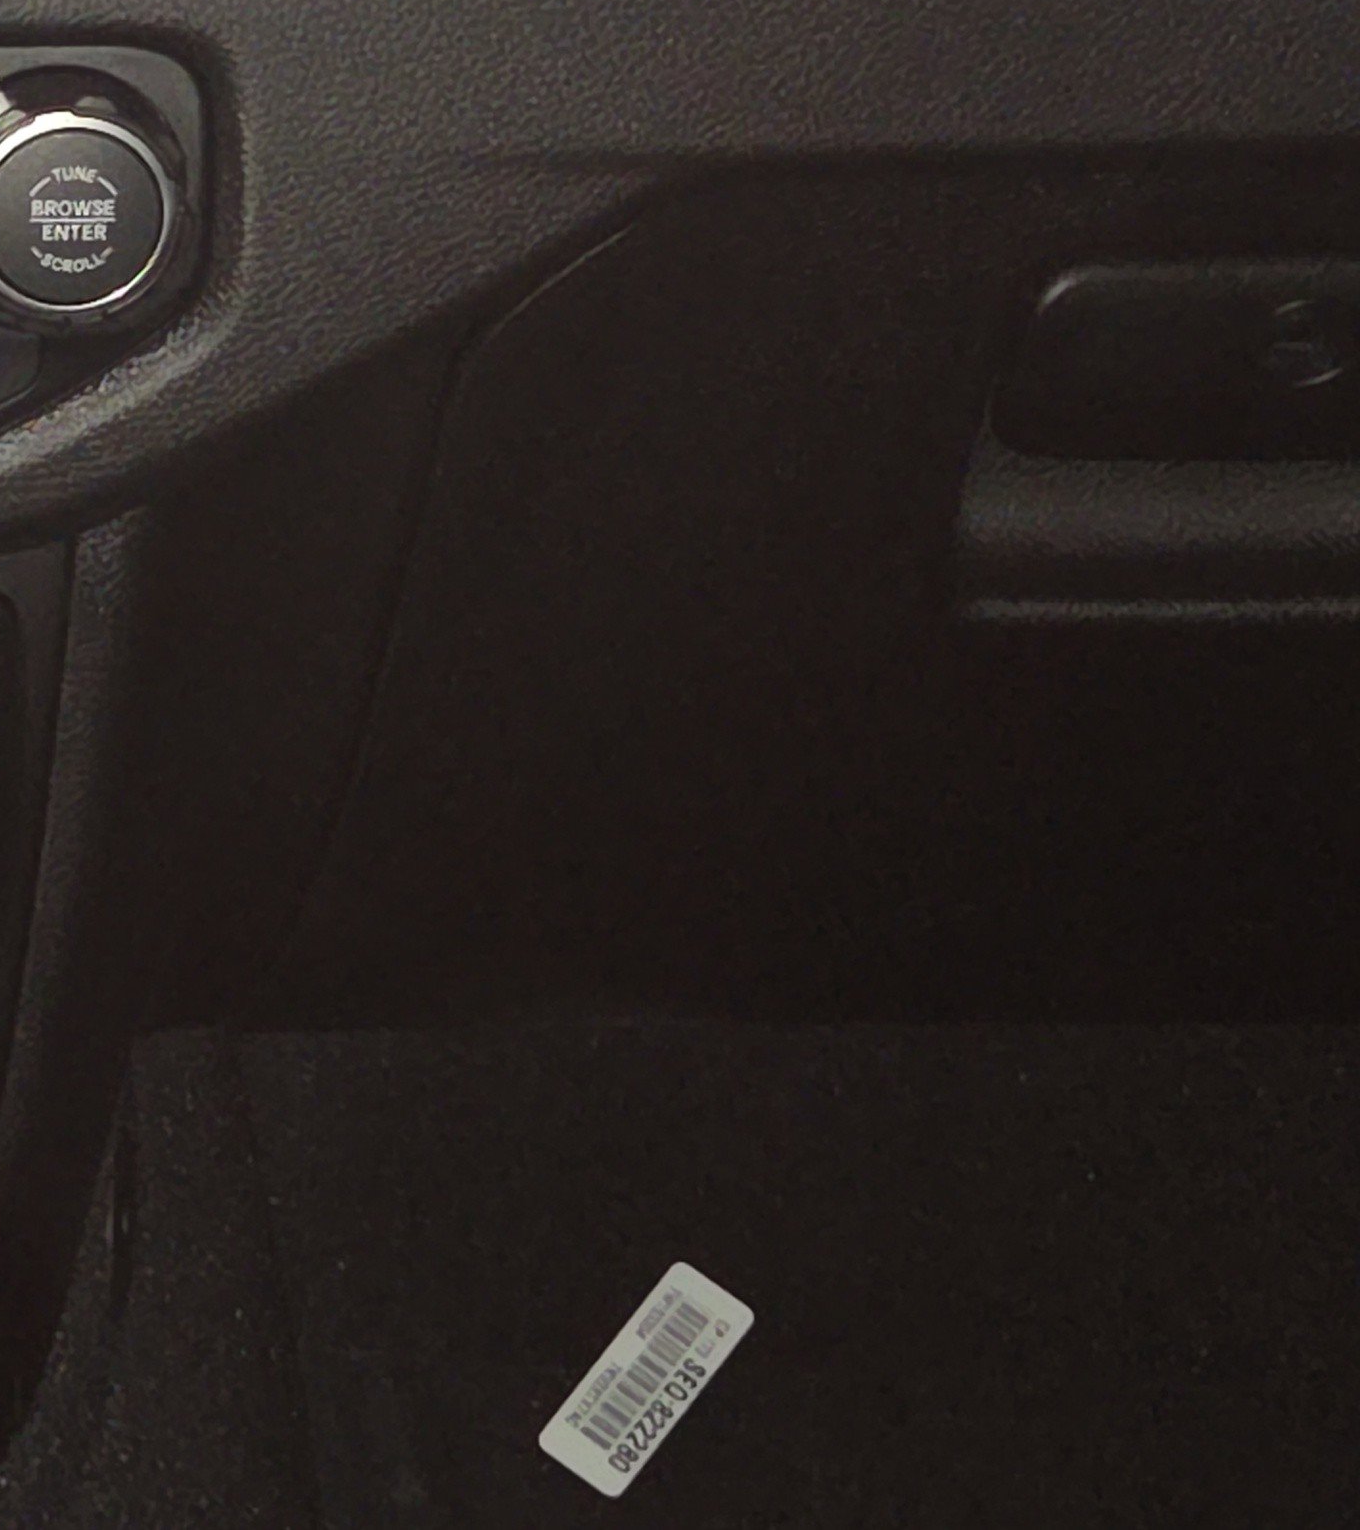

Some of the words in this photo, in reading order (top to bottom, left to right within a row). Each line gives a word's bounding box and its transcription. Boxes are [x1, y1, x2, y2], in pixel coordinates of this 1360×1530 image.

[51, 165, 98, 184] TUNE
[30, 199, 116, 217] BROWSE
[41, 224, 107, 241] ENTER
[40, 253, 106, 273] SCROLL
